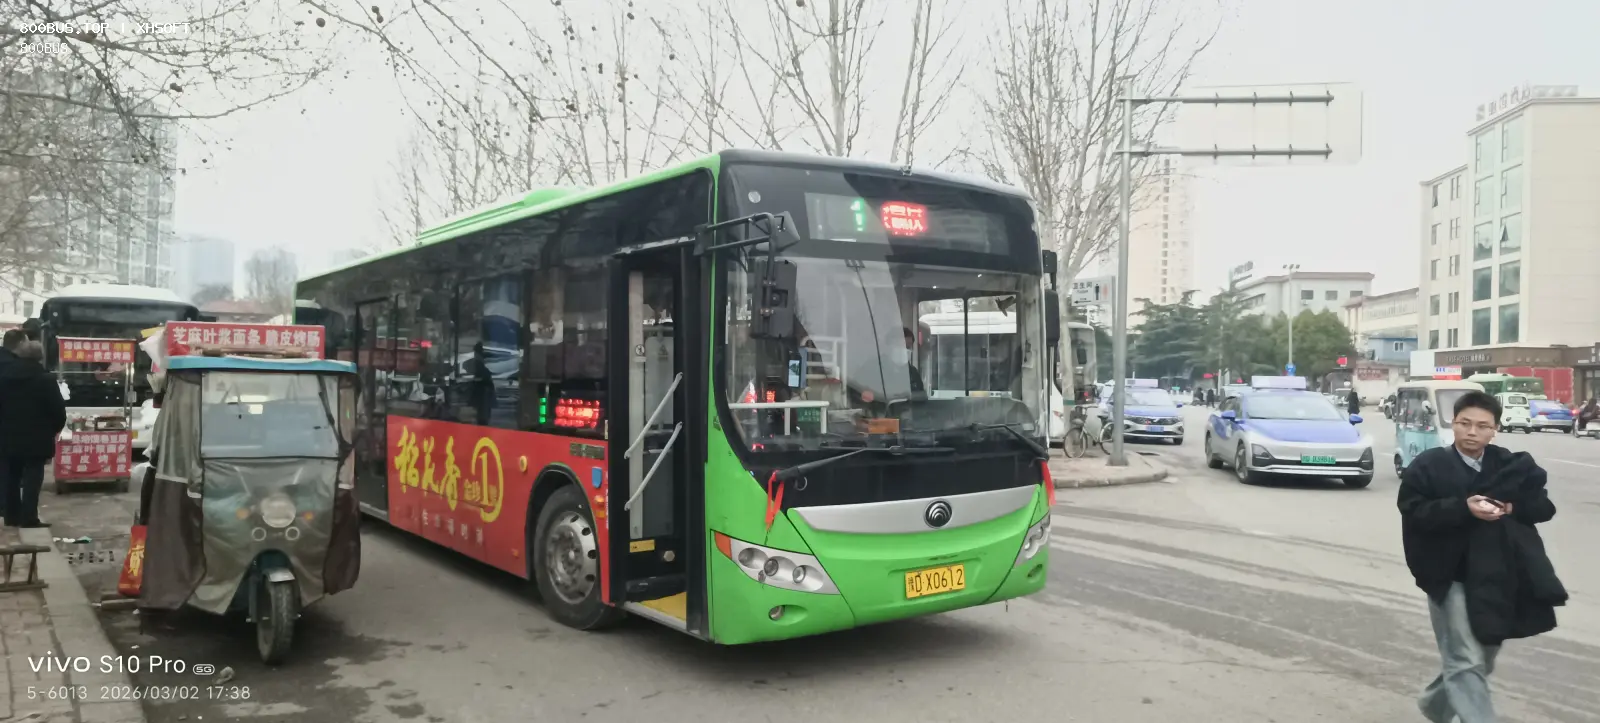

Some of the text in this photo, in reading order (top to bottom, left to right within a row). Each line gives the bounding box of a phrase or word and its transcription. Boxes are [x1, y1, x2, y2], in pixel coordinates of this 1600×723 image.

[172, 326, 320, 348] 芝麻叶浆面条 脆皮烤肠
